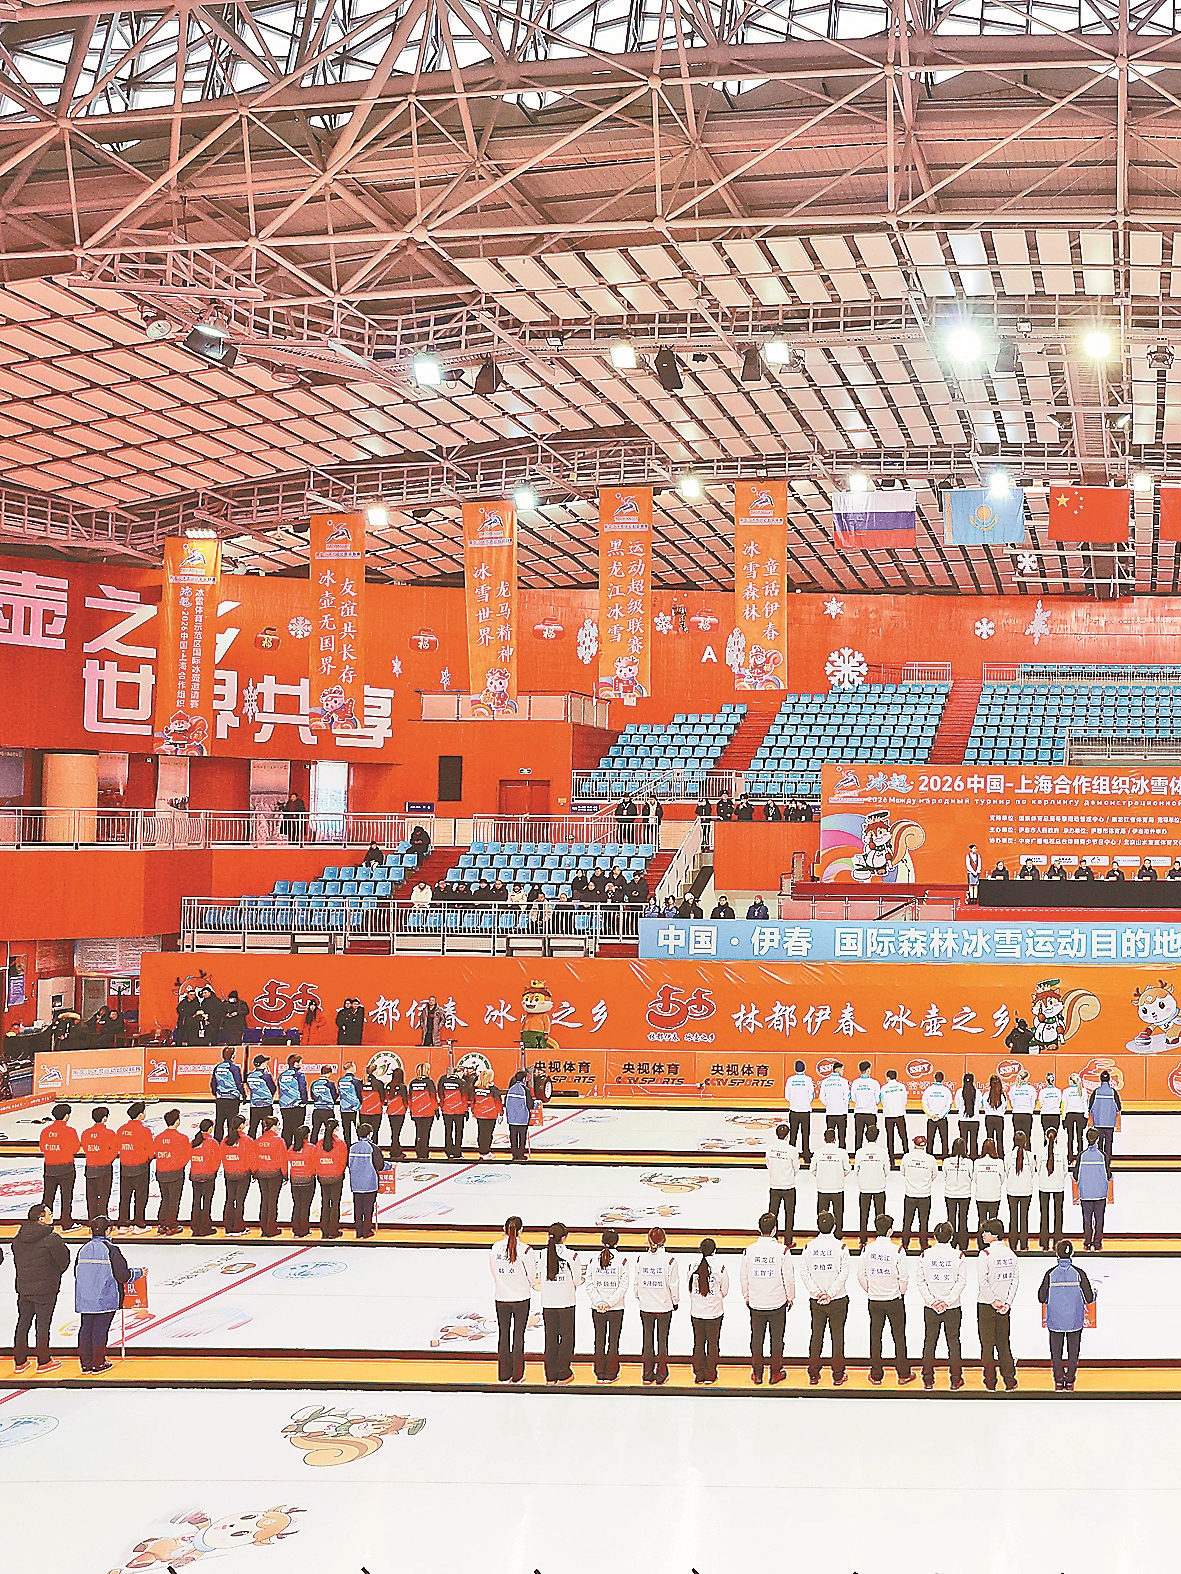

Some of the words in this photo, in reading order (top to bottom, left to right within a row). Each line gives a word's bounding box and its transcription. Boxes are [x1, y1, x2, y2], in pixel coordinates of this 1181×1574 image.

[318, 569, 337, 676] 冰壶无国界
[473, 562, 494, 647] 冰雪世界
[495, 580, 514, 663] 龙马精神
[607, 539, 626, 643] 黑龙江冰雪
[627, 540, 646, 655] 运动超级联赛
[742, 541, 761, 621] 冰雪森林
[762, 558, 781, 641] 童话伊春
[338, 577, 358, 684] 友谊共长存
[701, 645, 718, 663] A
[484, 998, 609, 1034] 冰之乡
[731, 1000, 868, 1039] 林都伊春
[883, 1003, 1011, 1039] 冰壶之乡
[622, 1061, 680, 1075] 央视体育
[711, 1062, 770, 1076] 央视体育
